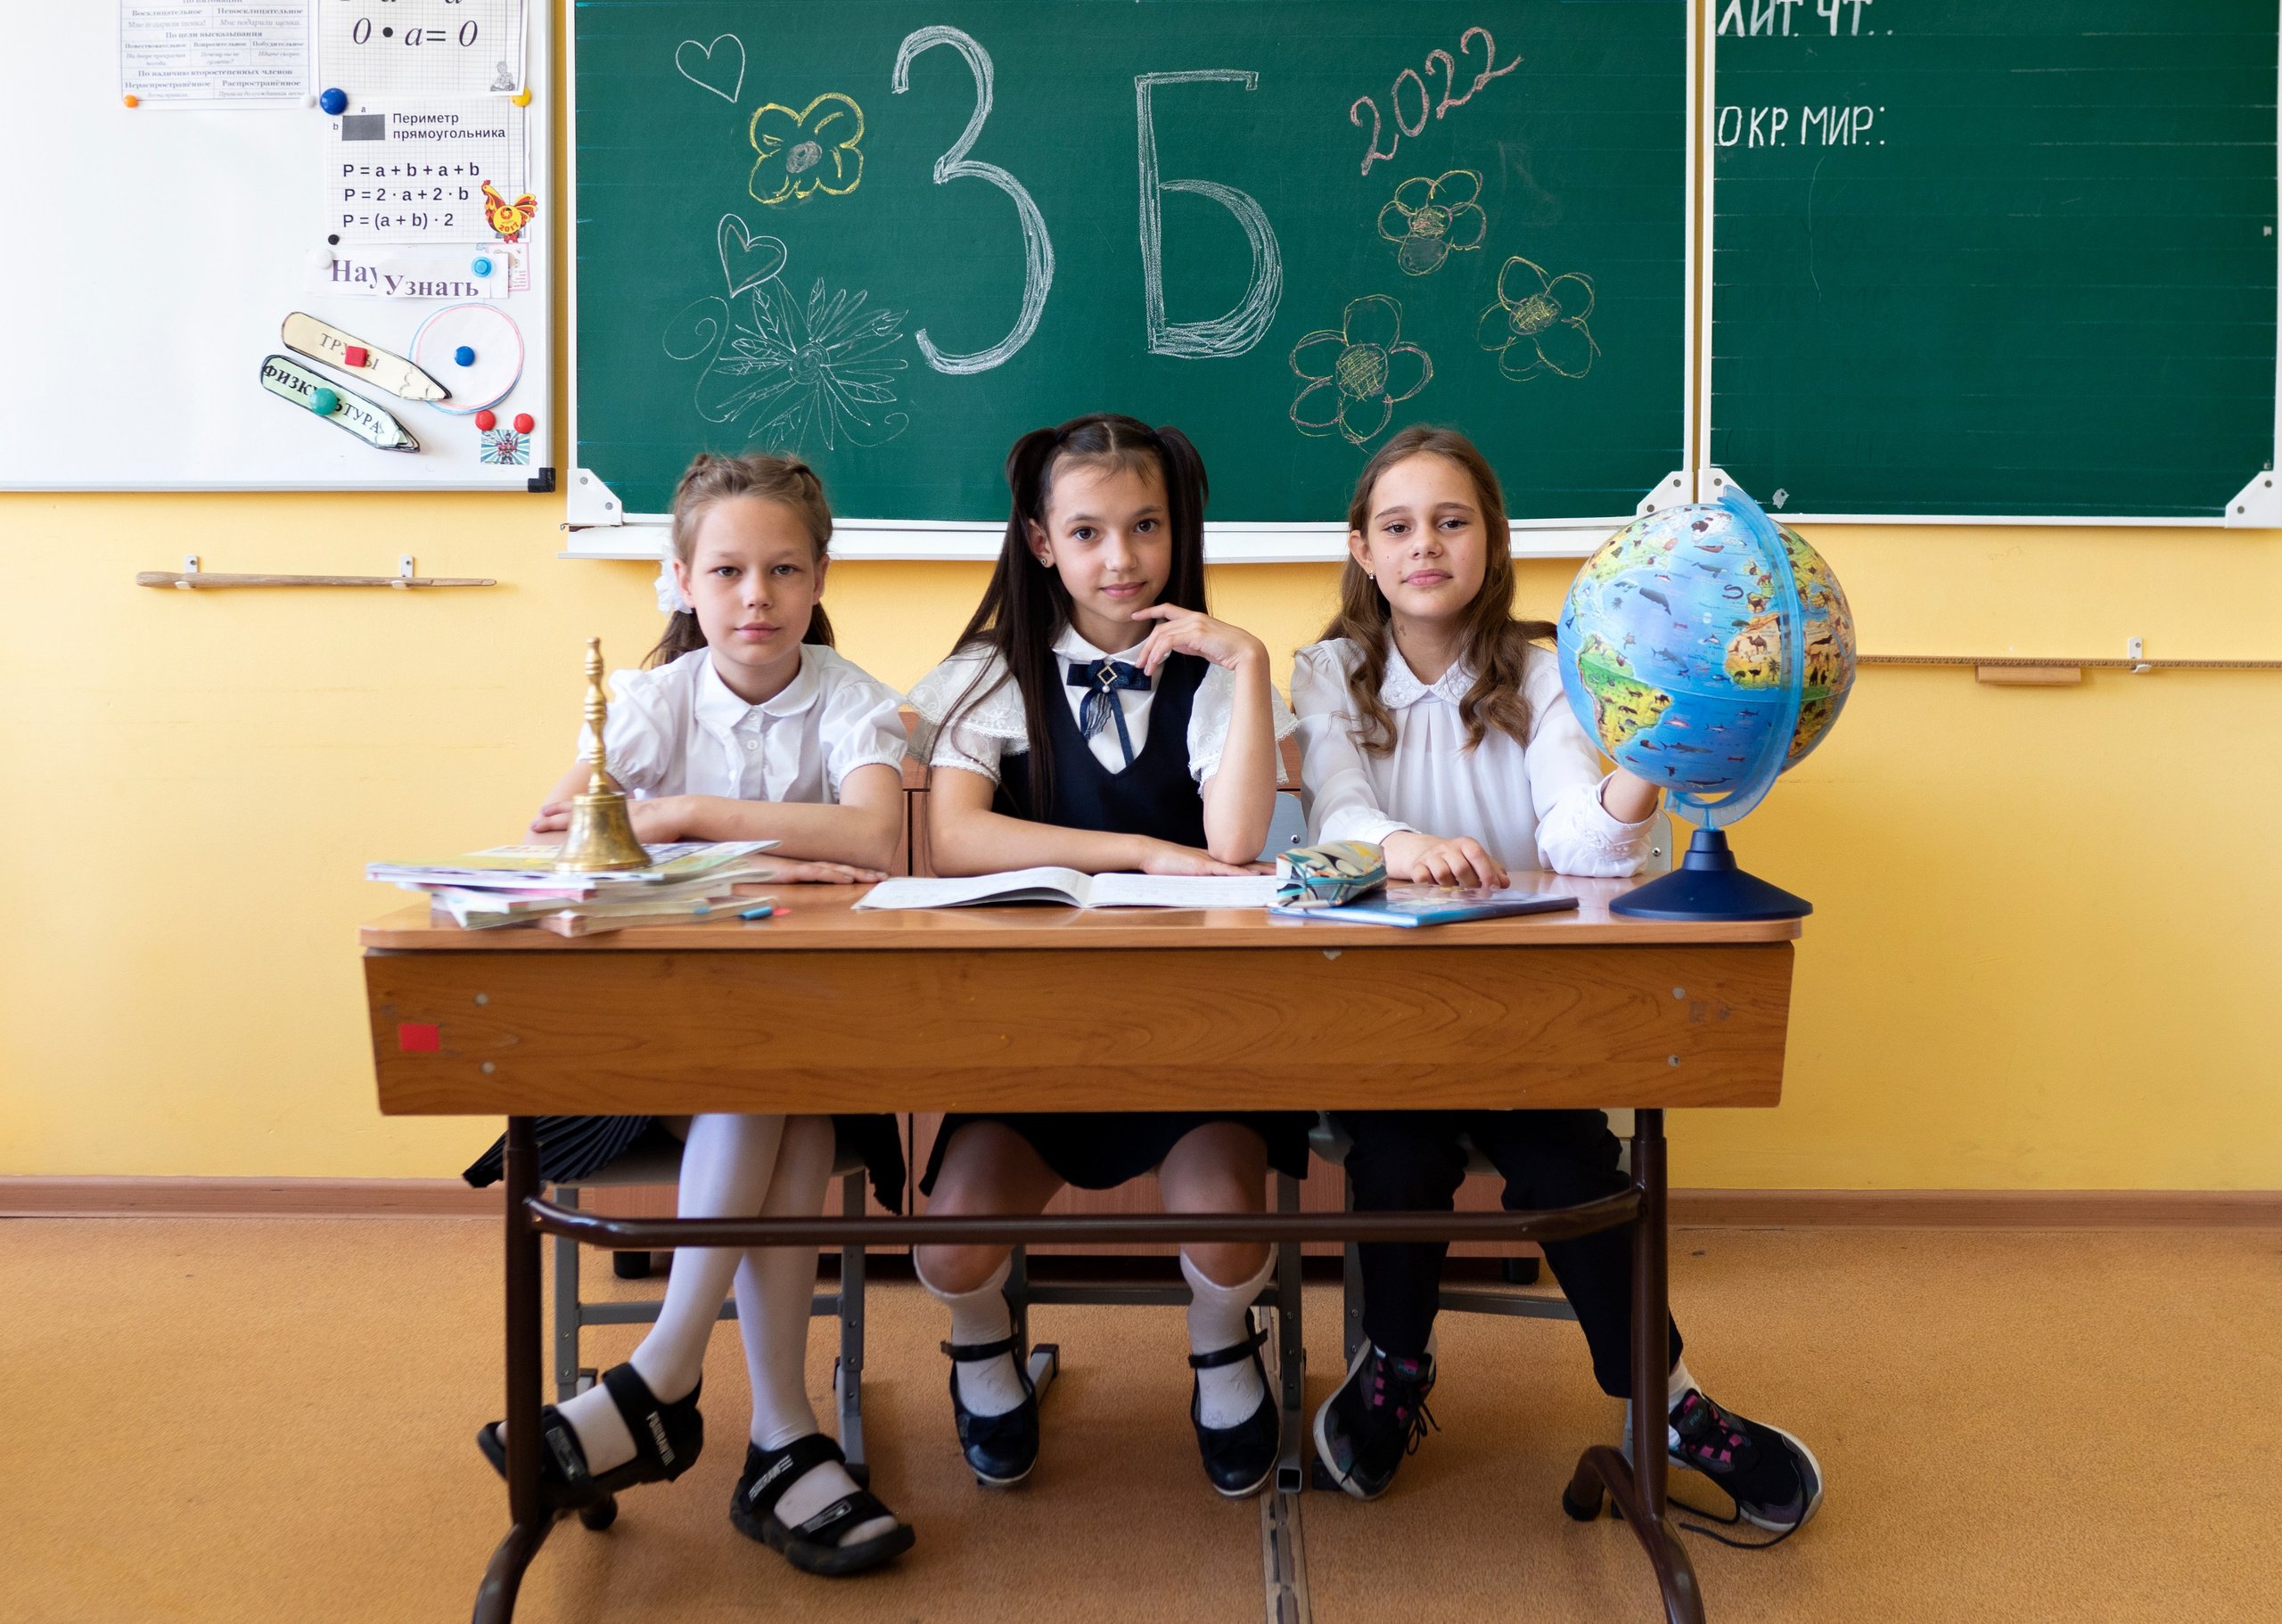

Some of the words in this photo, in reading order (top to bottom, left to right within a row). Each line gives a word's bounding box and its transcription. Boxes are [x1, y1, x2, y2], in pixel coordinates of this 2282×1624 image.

[353, 18, 372, 45] 0
[459, 20, 478, 46] 0
[1350, 26, 1523, 176] 2022
[392, 113, 459, 126] Периметр
[1718, 106, 1788, 148] ОКР.
[393, 129, 505, 141] прямоугольника
[343, 164, 354, 176] P
[375, 166, 385, 177] a
[406, 163, 417, 177] b
[439, 166, 448, 176] a
[470, 162, 480, 176] b
[344, 188, 355, 201] P
[376, 188, 386, 201] 2
[402, 190, 412, 201] a
[433, 188, 442, 201] 2
[459, 187, 469, 201] b
[892, 25, 1055, 374] 3
[1134, 69, 1283, 359] Б
[343, 215, 354, 227] P
[444, 213, 454, 226] 2
[498, 221, 519, 232] 2017
[383, 275, 479, 296] Узнать
